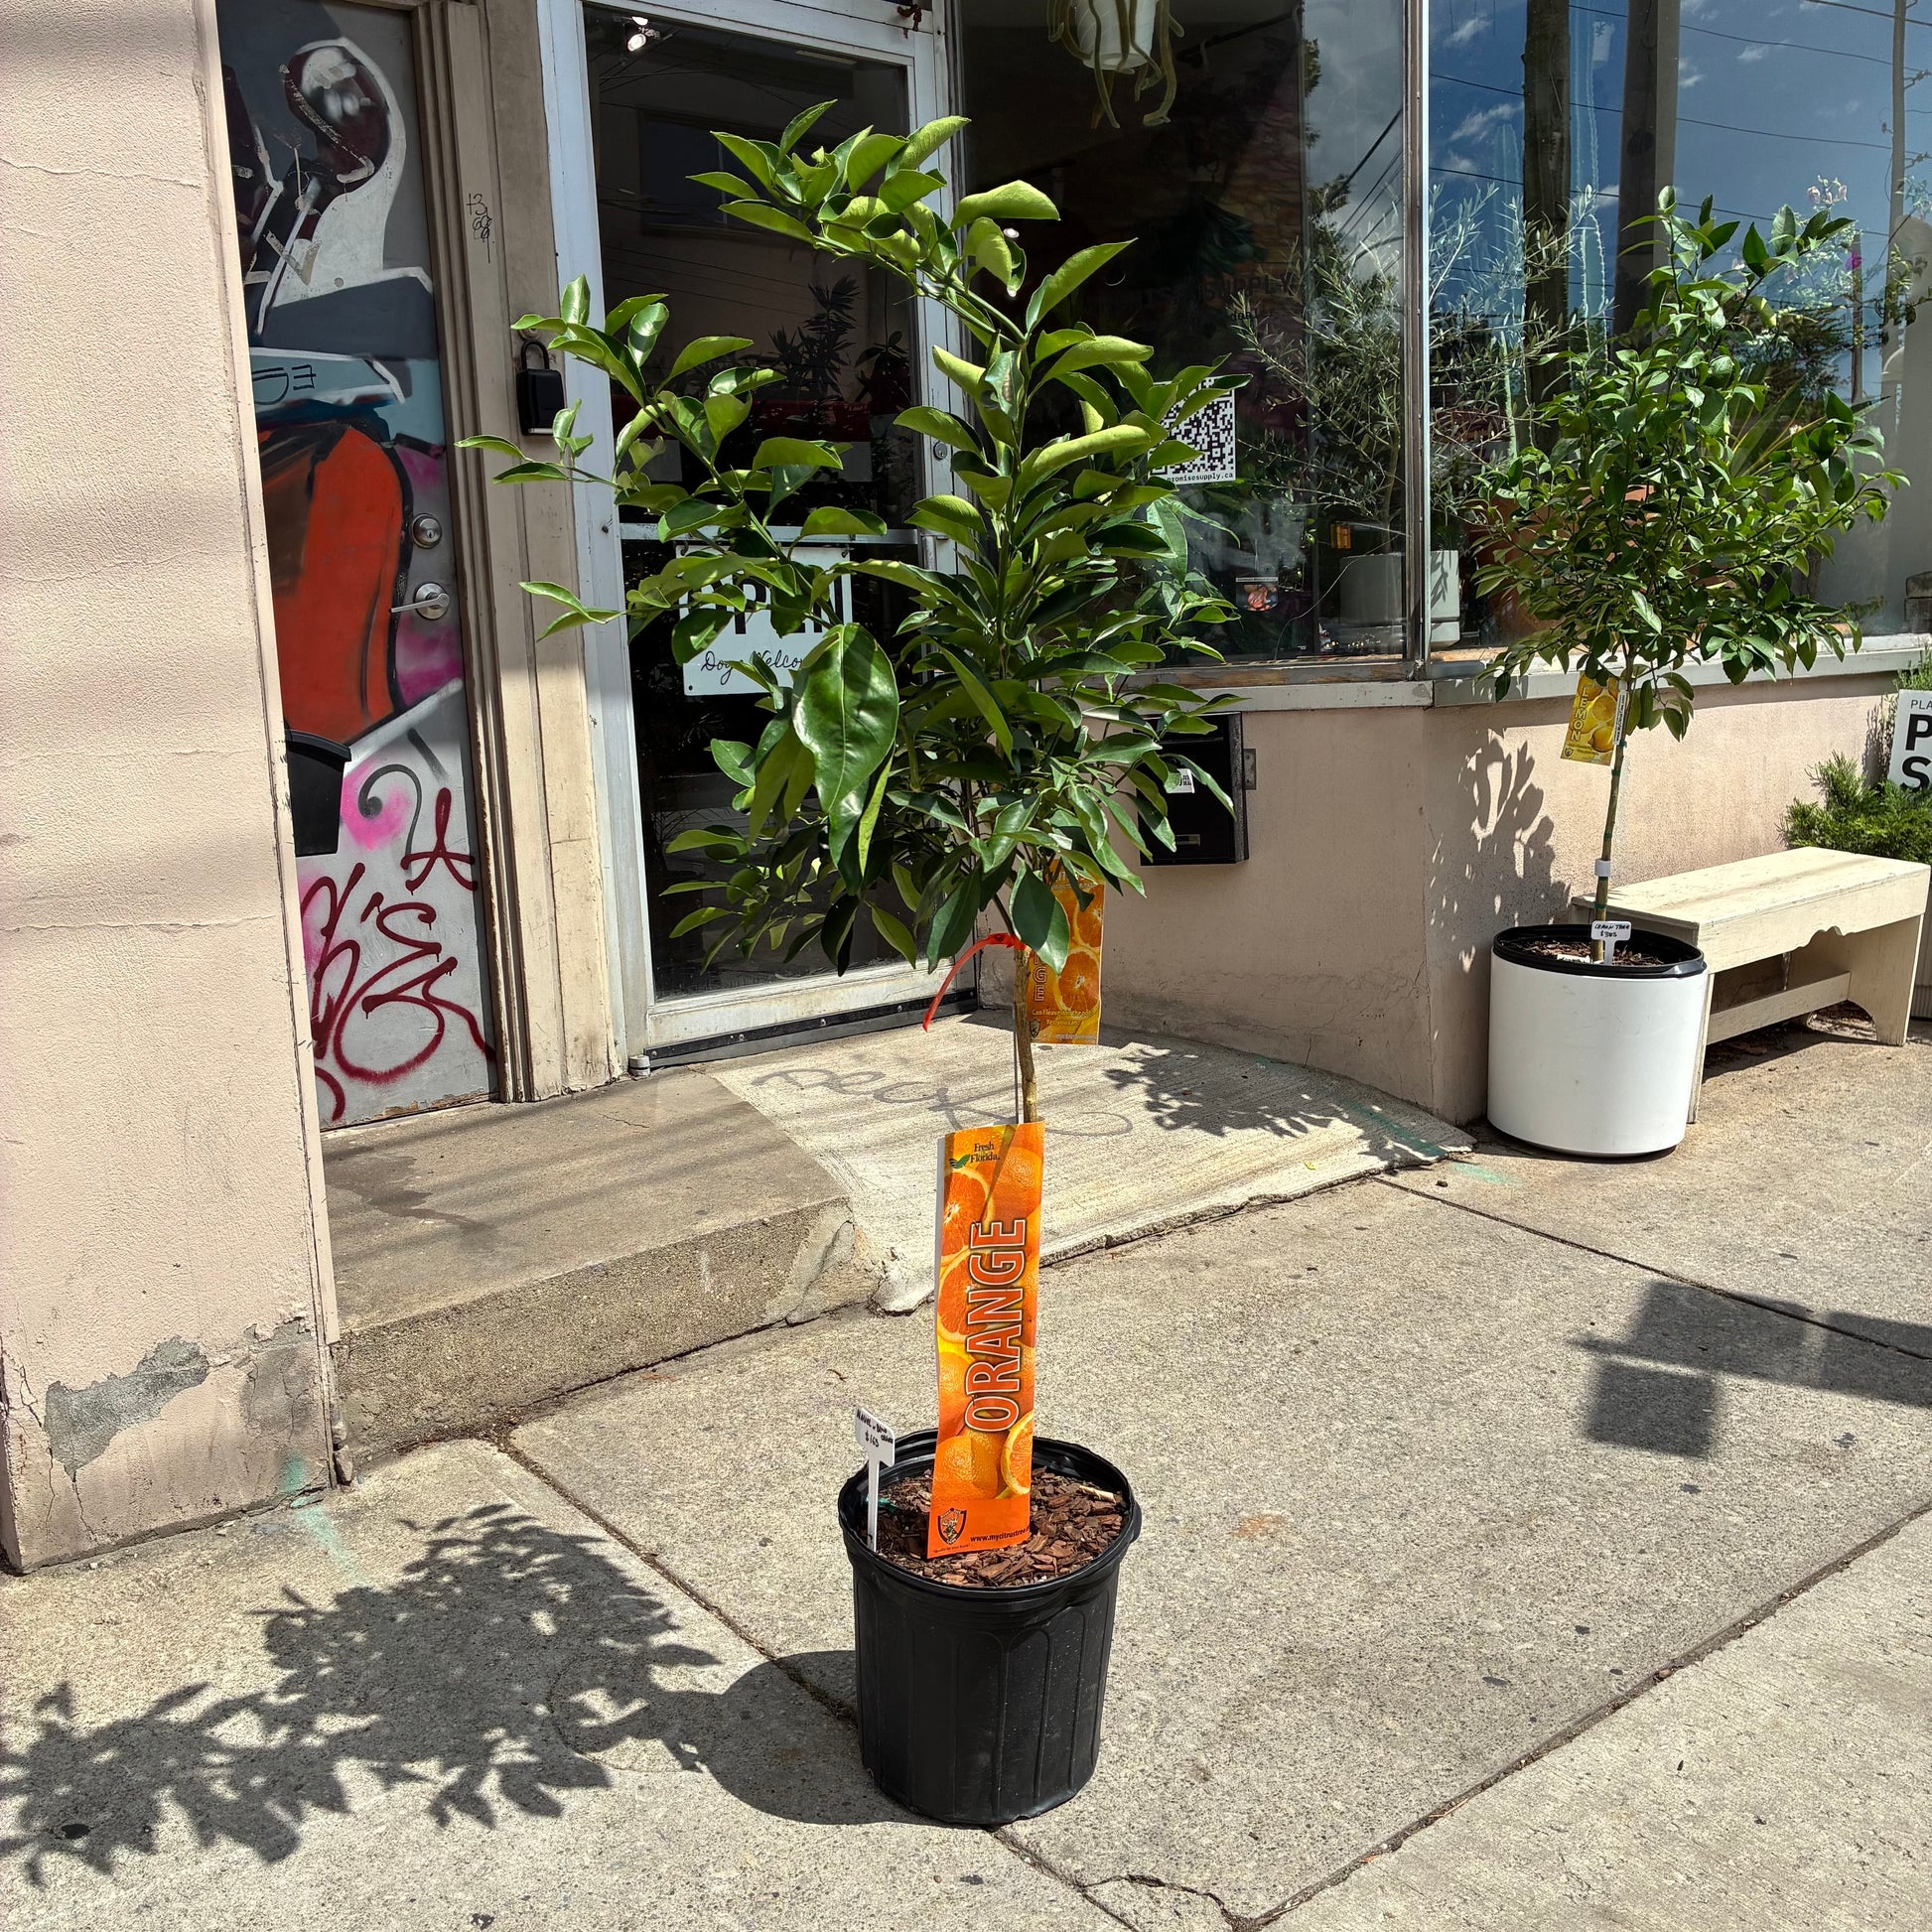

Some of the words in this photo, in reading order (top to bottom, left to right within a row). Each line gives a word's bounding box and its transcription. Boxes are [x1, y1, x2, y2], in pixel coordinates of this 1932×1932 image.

[1570, 685, 1588, 742] LEMON
[974, 1141, 994, 1152] Fresh
[964, 1219, 1027, 1433] ORANGE
